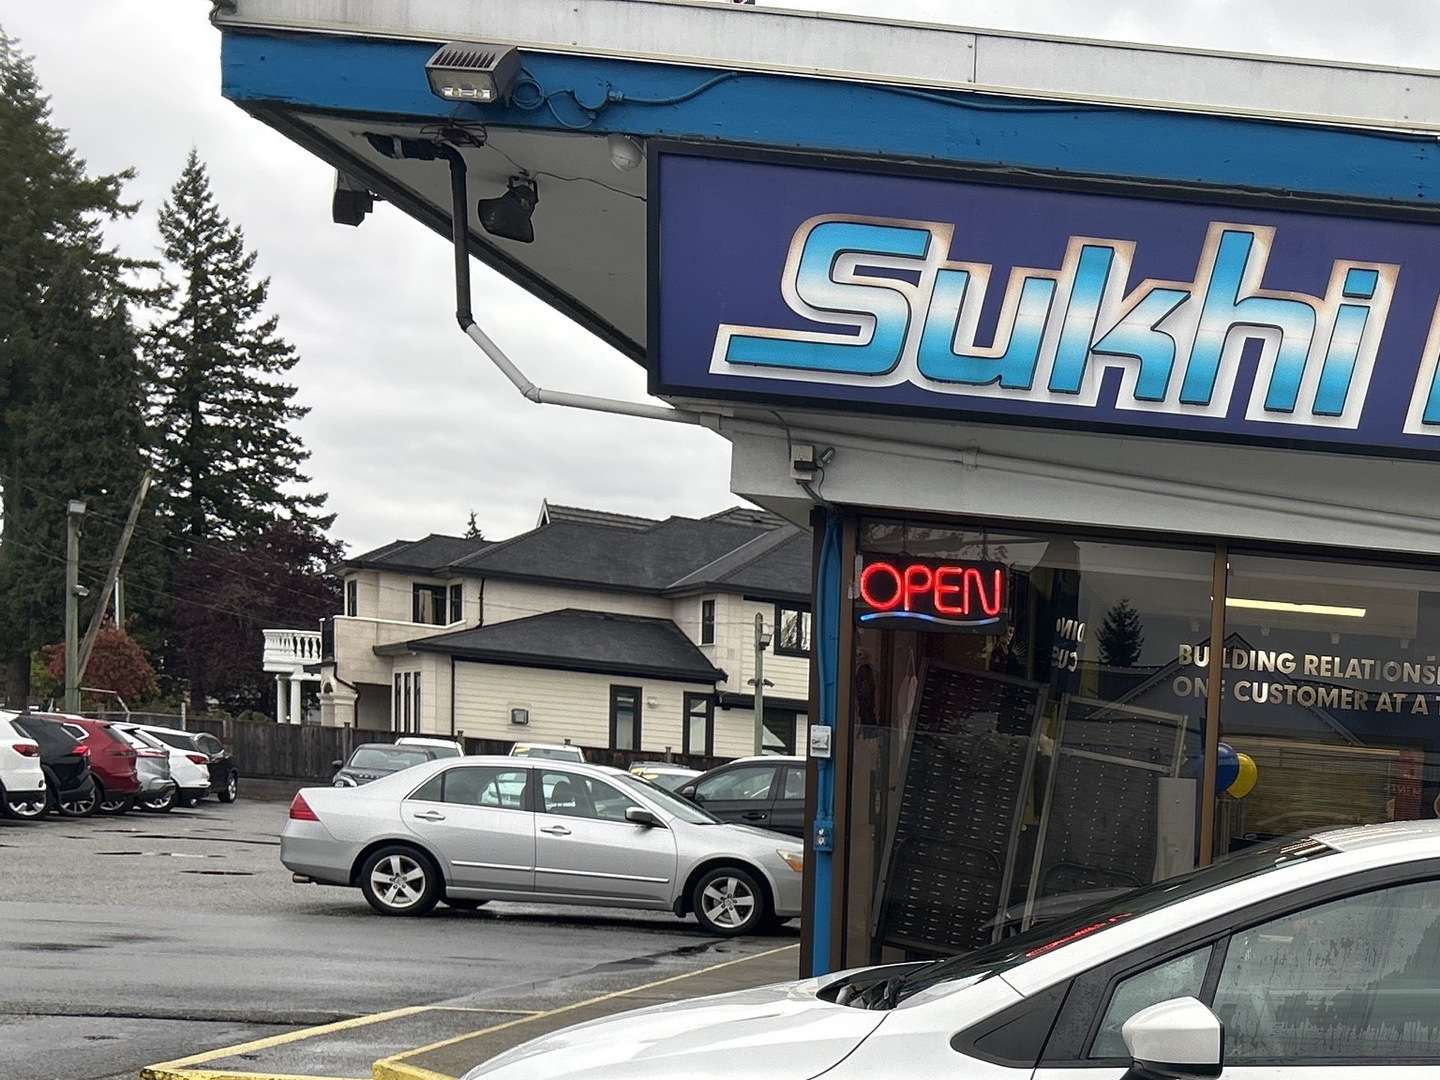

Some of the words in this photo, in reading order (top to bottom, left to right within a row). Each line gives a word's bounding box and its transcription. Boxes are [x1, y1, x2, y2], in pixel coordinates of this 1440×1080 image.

[709, 214, 1398, 428] Sukhi
[861, 562, 1000, 616] OPEN
[1179, 644, 1296, 674] BULDING
[1234, 680, 1369, 711] CUSTOMER
[1375, 691, 1408, 713] AT
[1411, 695, 1429, 715] A
